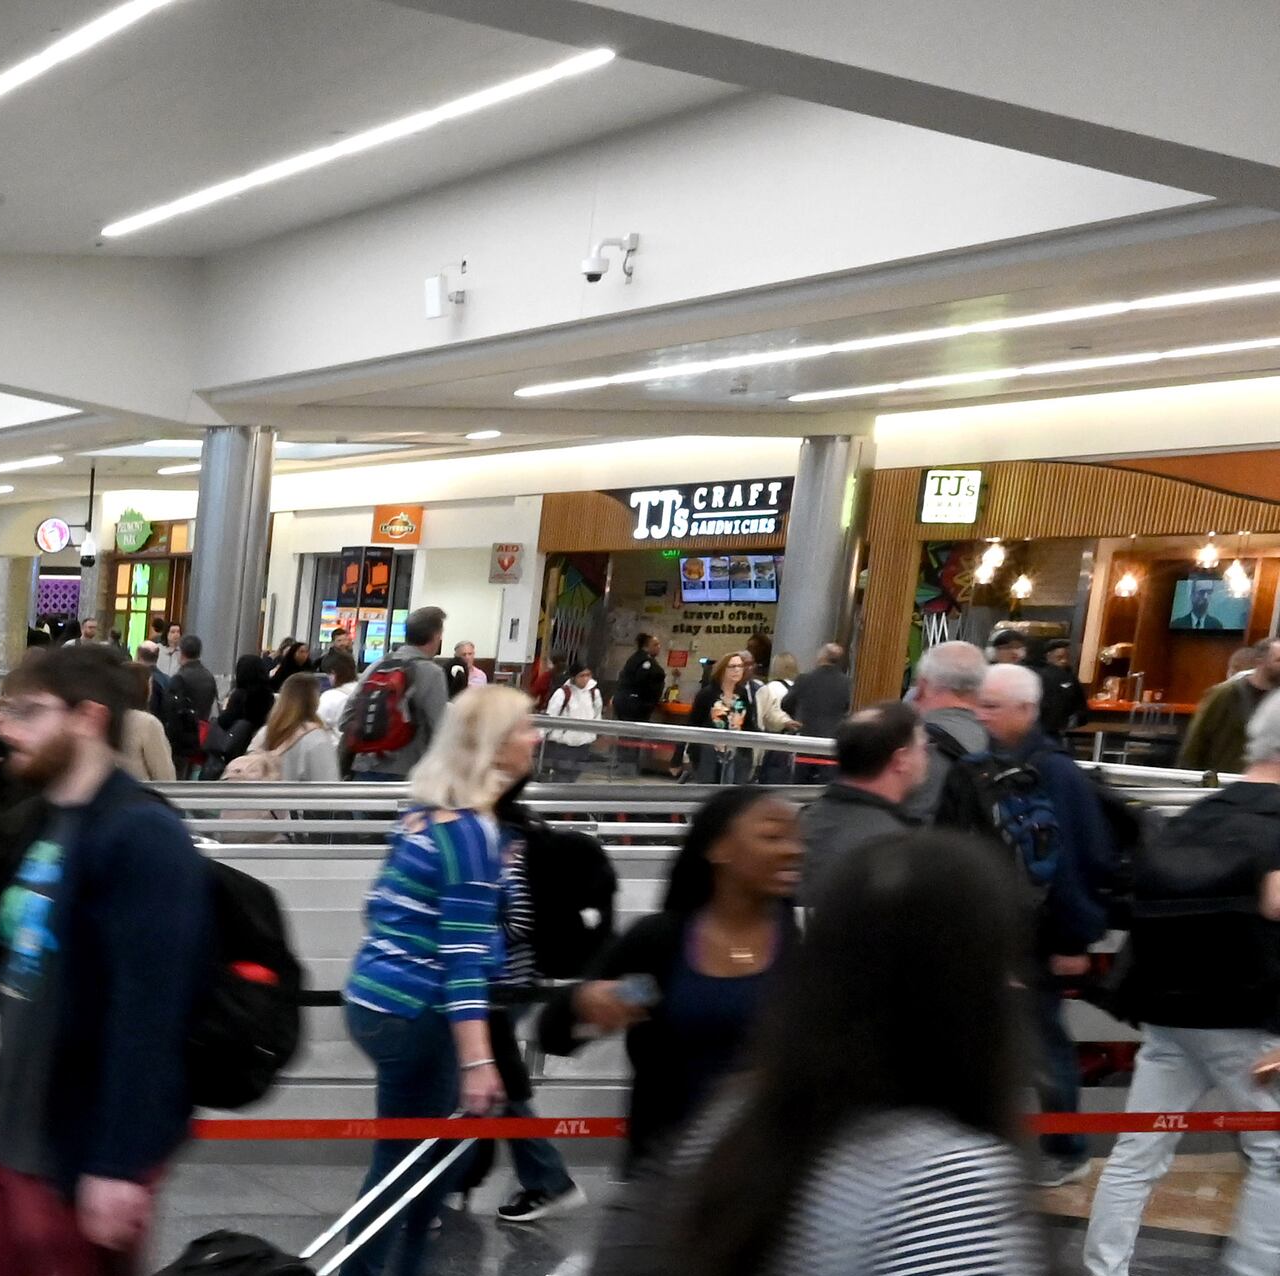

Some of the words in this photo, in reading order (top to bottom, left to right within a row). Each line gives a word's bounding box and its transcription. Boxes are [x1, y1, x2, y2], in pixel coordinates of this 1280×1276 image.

[694, 482, 782, 509] CRAFT
[690, 518, 775, 536] SANDWICHES
[683, 610, 724, 620] travel
[728, 610, 768, 622] often,
[672, 623, 701, 635] stay
[706, 622, 774, 635] authentic.
[554, 1120, 590, 1135] ATL
[1153, 1115, 1188, 1129] ATL
